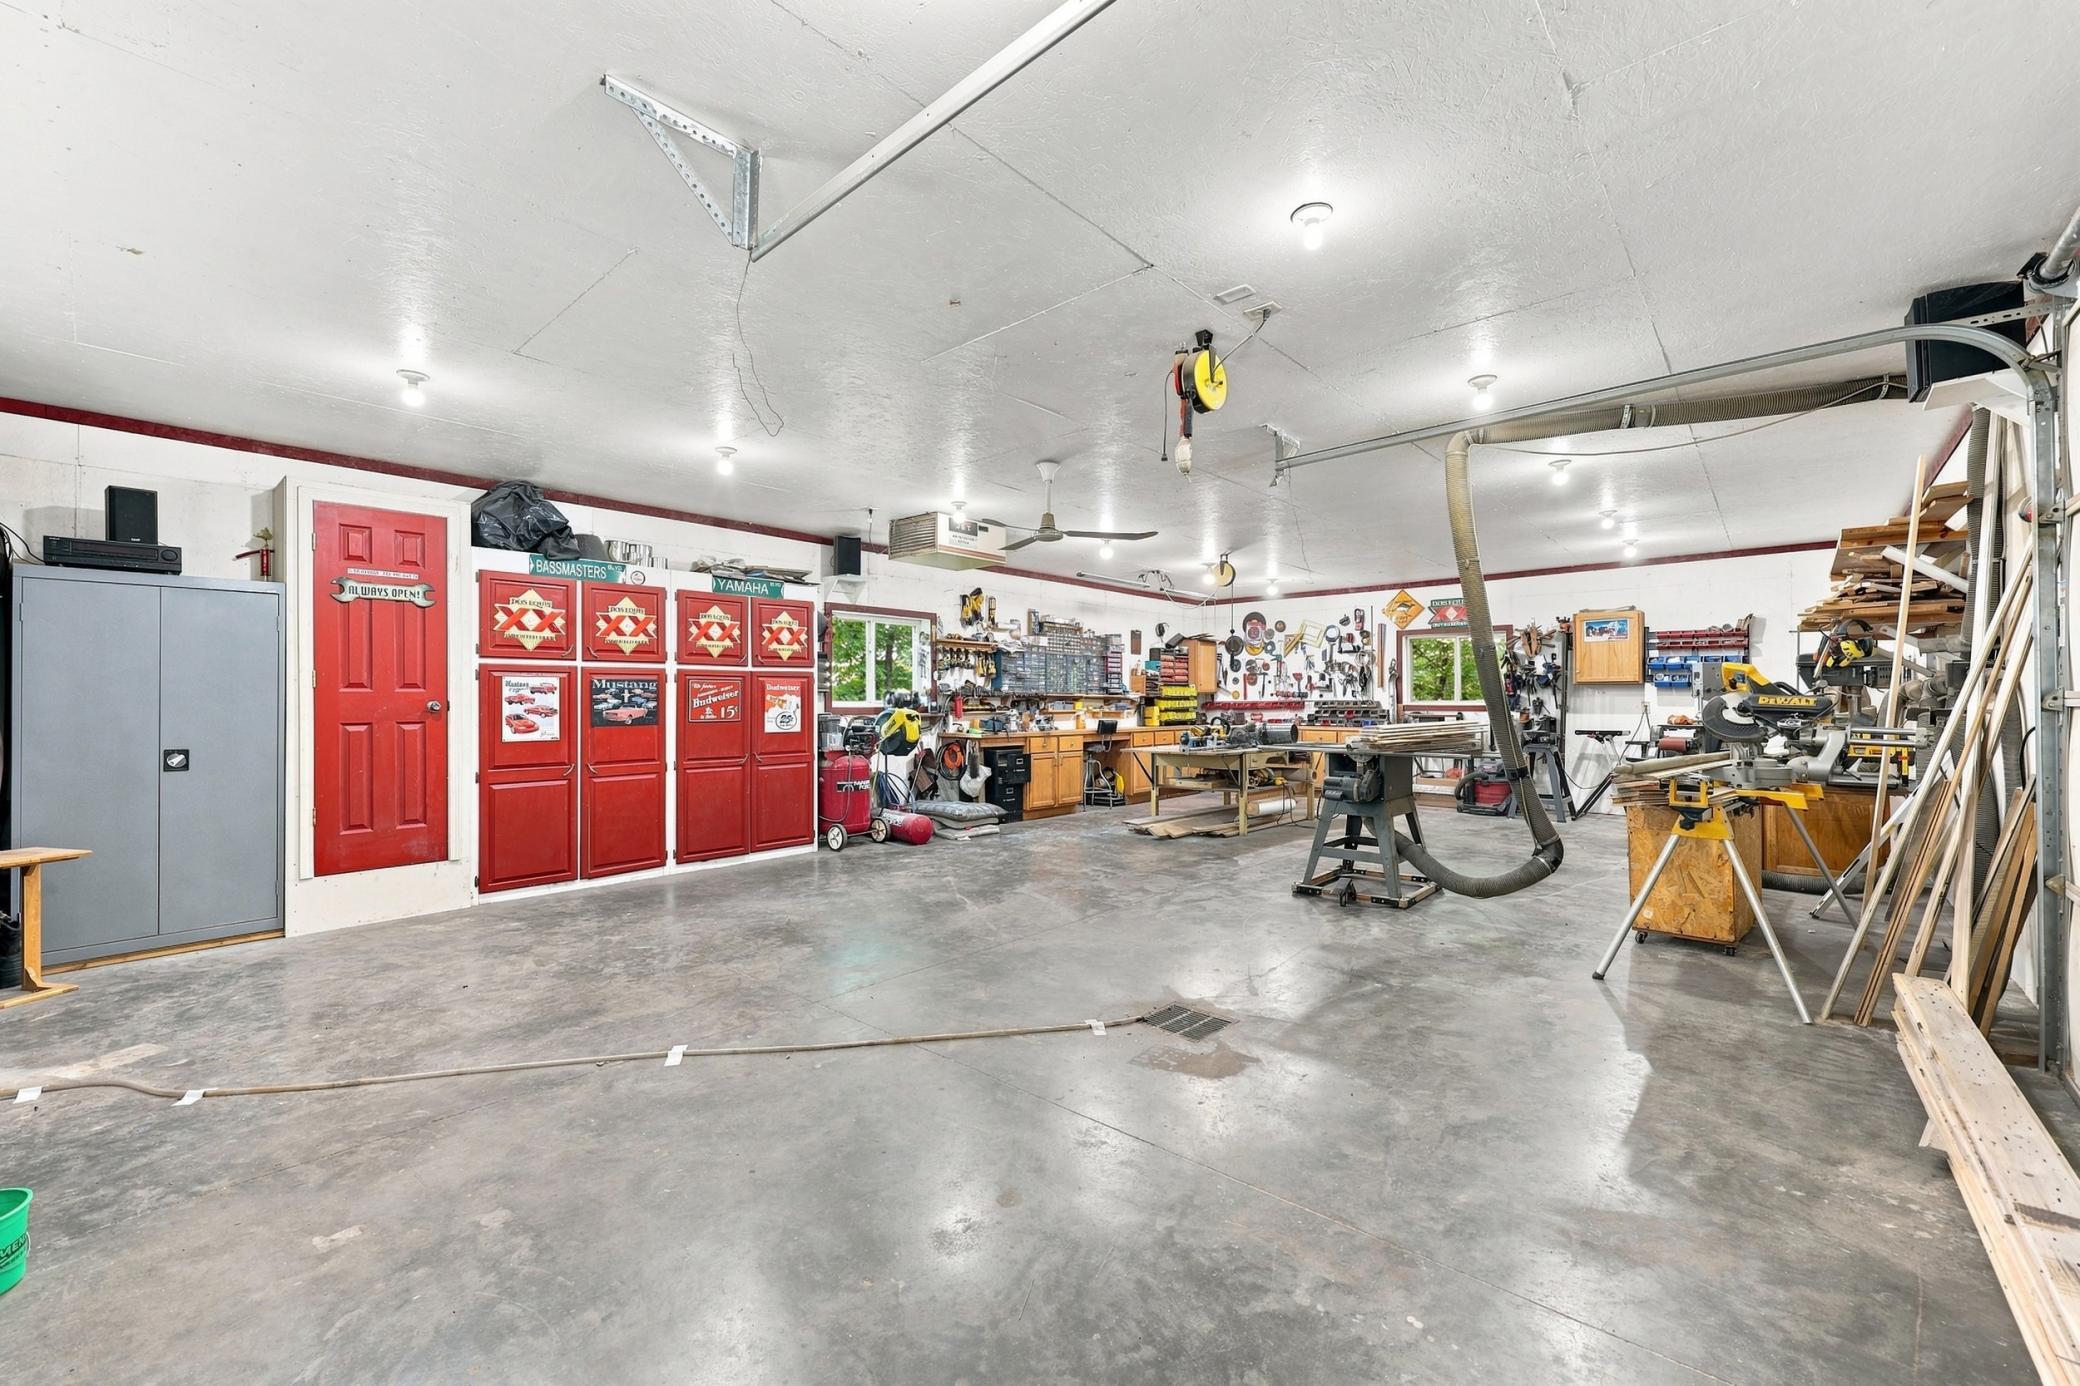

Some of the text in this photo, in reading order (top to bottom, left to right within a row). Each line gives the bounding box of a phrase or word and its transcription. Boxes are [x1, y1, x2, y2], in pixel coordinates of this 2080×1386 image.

[535, 559, 607, 579] BASSMASTERS
[348, 585, 421, 599] ALWAYS OPEN!
[717, 579, 769, 595] YAMAHA
[592, 679, 657, 690] Mustang
[766, 683, 801, 691] Budweiser
[692, 690, 739, 708] Budweiser
